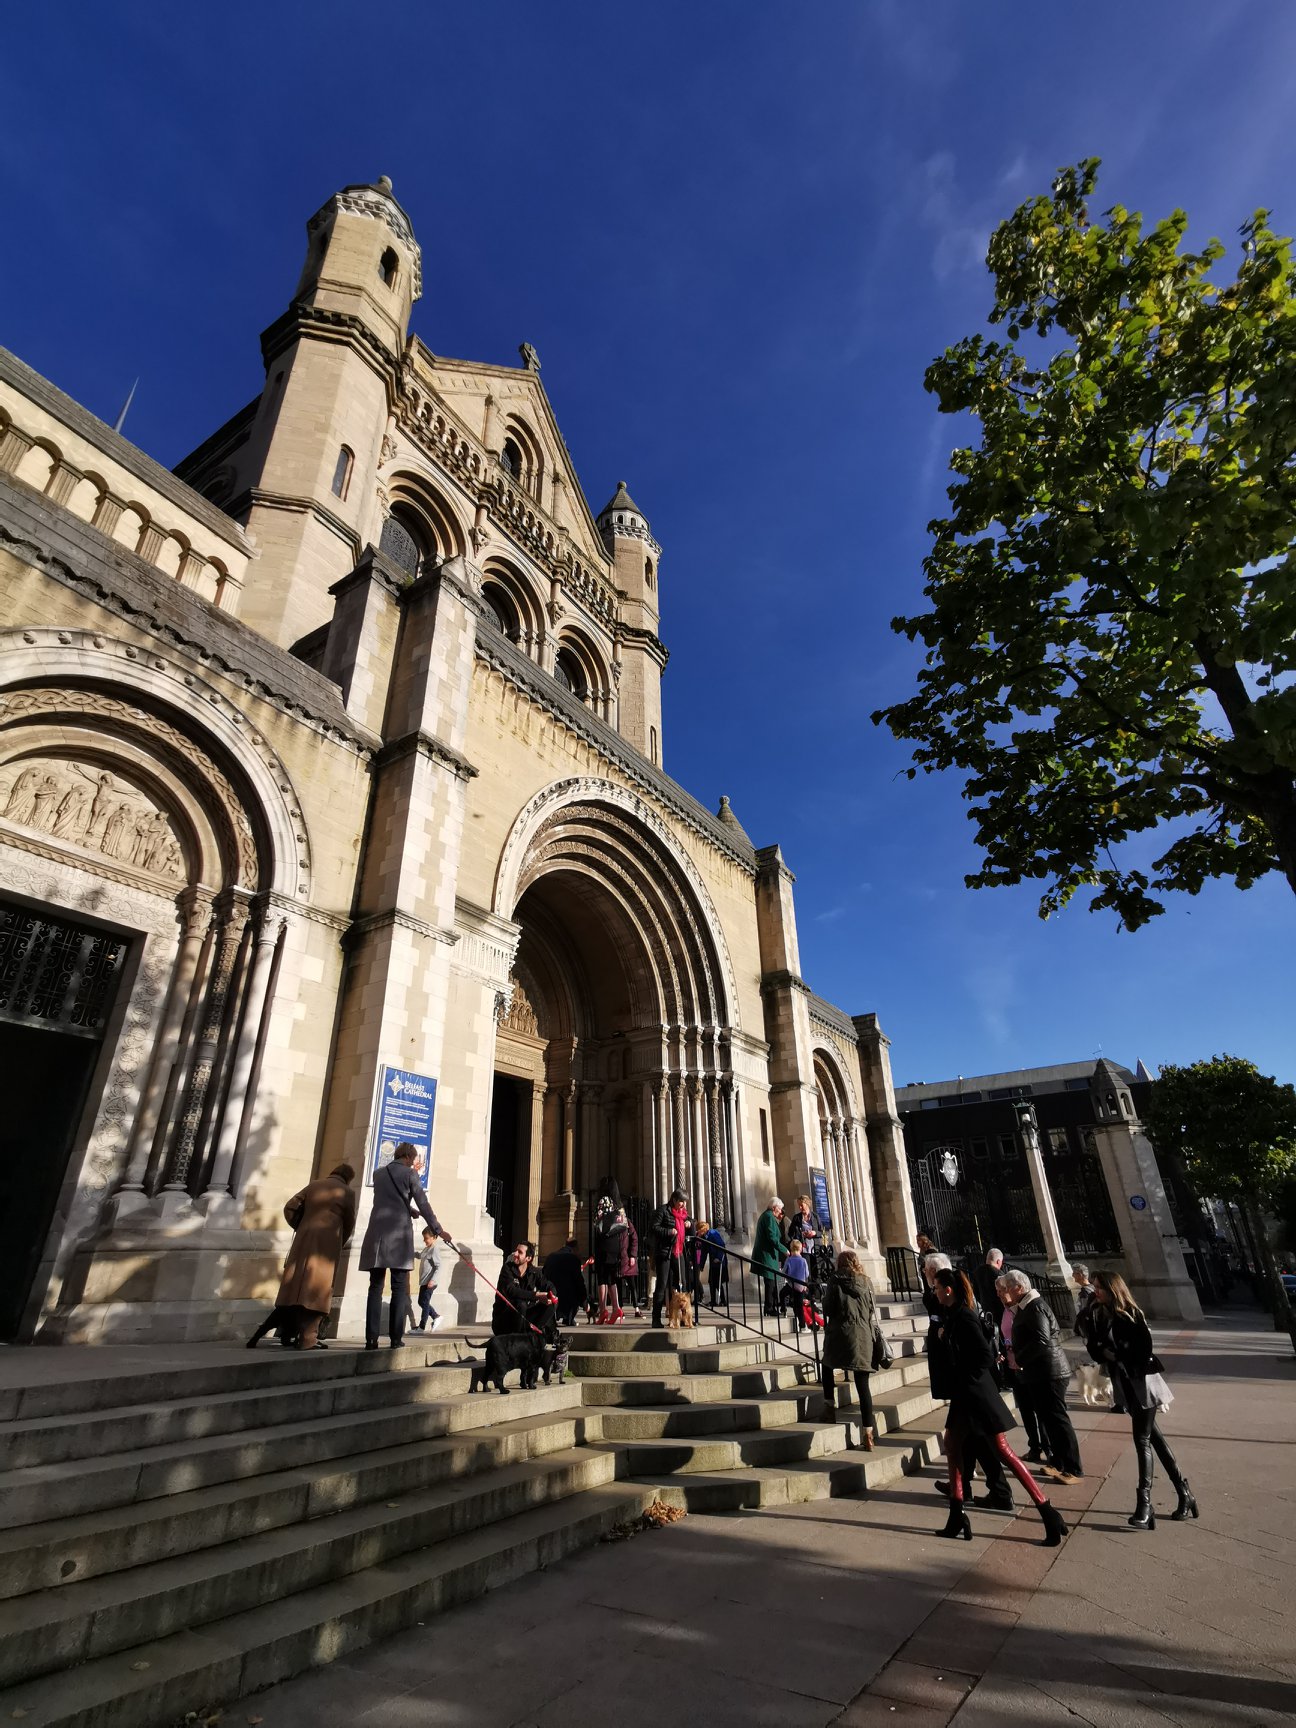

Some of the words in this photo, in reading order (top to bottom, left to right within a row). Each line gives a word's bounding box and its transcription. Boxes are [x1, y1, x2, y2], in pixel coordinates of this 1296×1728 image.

[16, 851, 62, 875] LOSETH
[66, 867, 82, 881] HIS
[87, 874, 106, 888] LIFE
[110, 884, 141, 901] SHALL
[405, 1081, 424, 1091] BELFAST
[404, 1088, 432, 1099] CATHEDRAL
